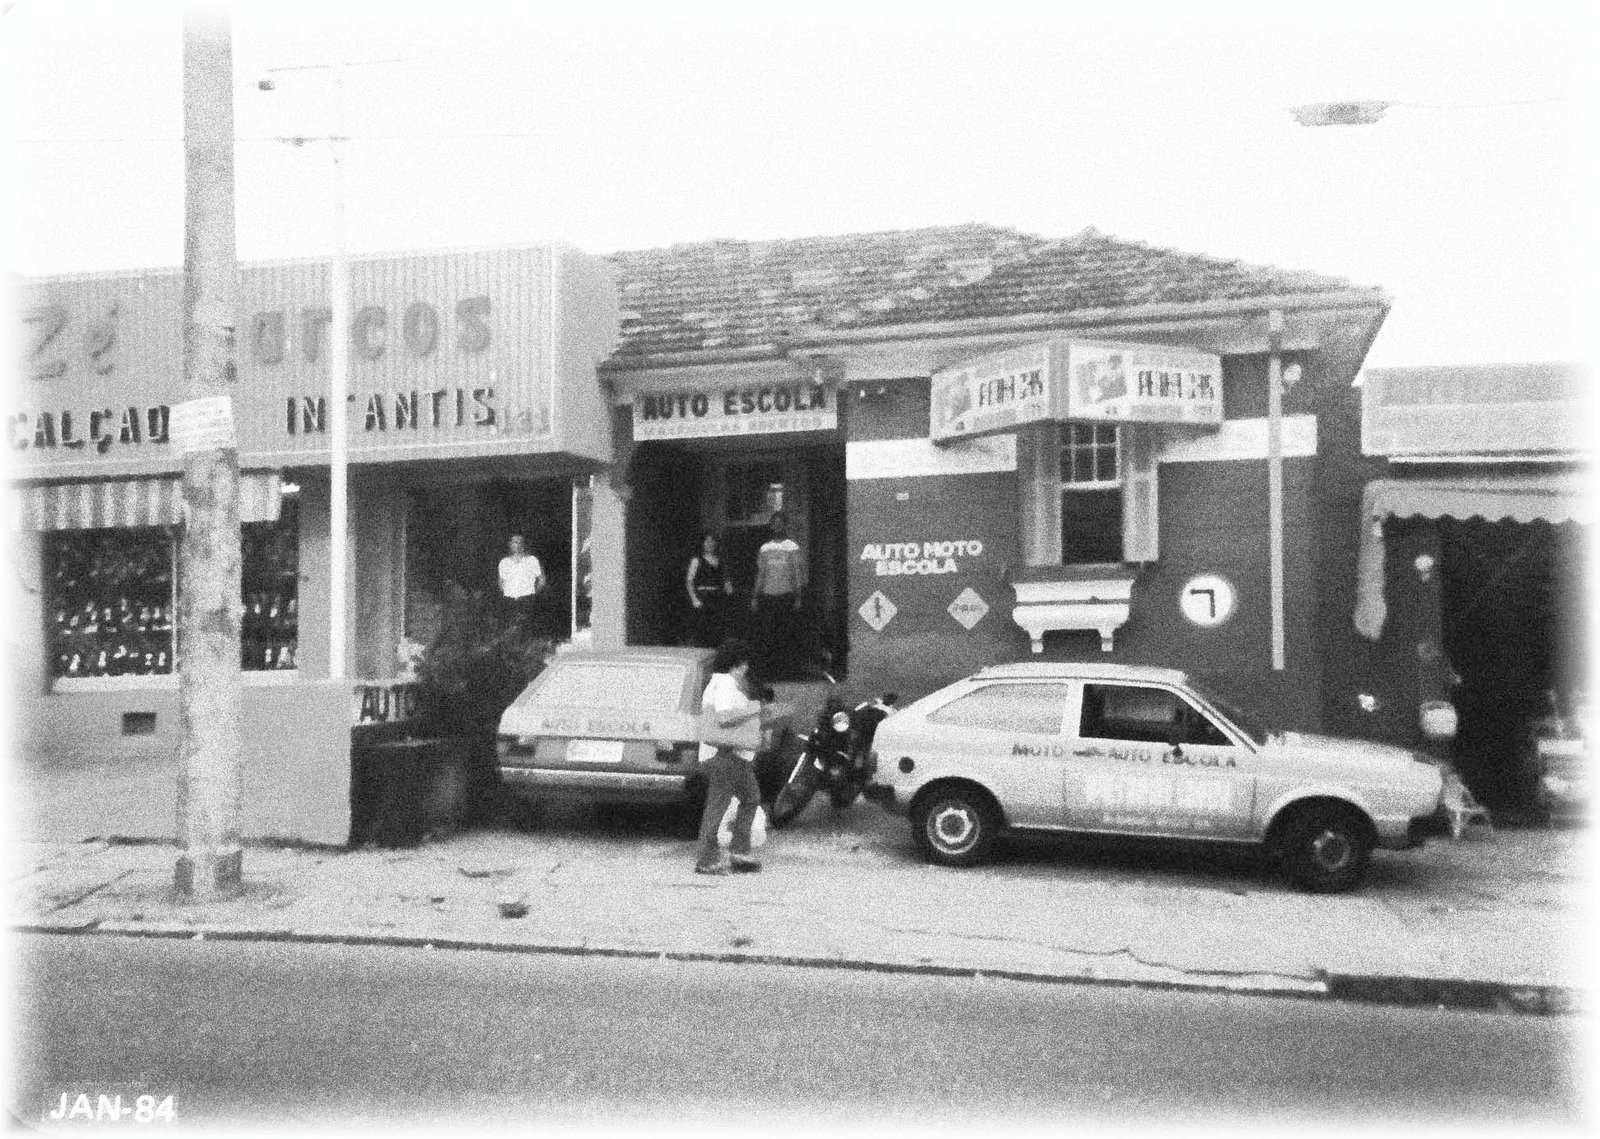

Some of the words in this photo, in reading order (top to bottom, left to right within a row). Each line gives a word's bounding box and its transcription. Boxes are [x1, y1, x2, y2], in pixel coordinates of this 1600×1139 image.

[252, 296, 490, 365] arcos
[287, 388, 496, 434] INANTIS
[643, 393, 708, 420] AUTO
[724, 384, 826, 416] ESCOLA
[860, 543, 920, 560] AUTO
[923, 540, 983, 558] MOTO
[875, 558, 957, 577] ESCOLA
[1012, 742, 1063, 757] MOTO
[1108, 748, 1151, 763] AUTO
[1162, 750, 1236, 769] ESCOLA
